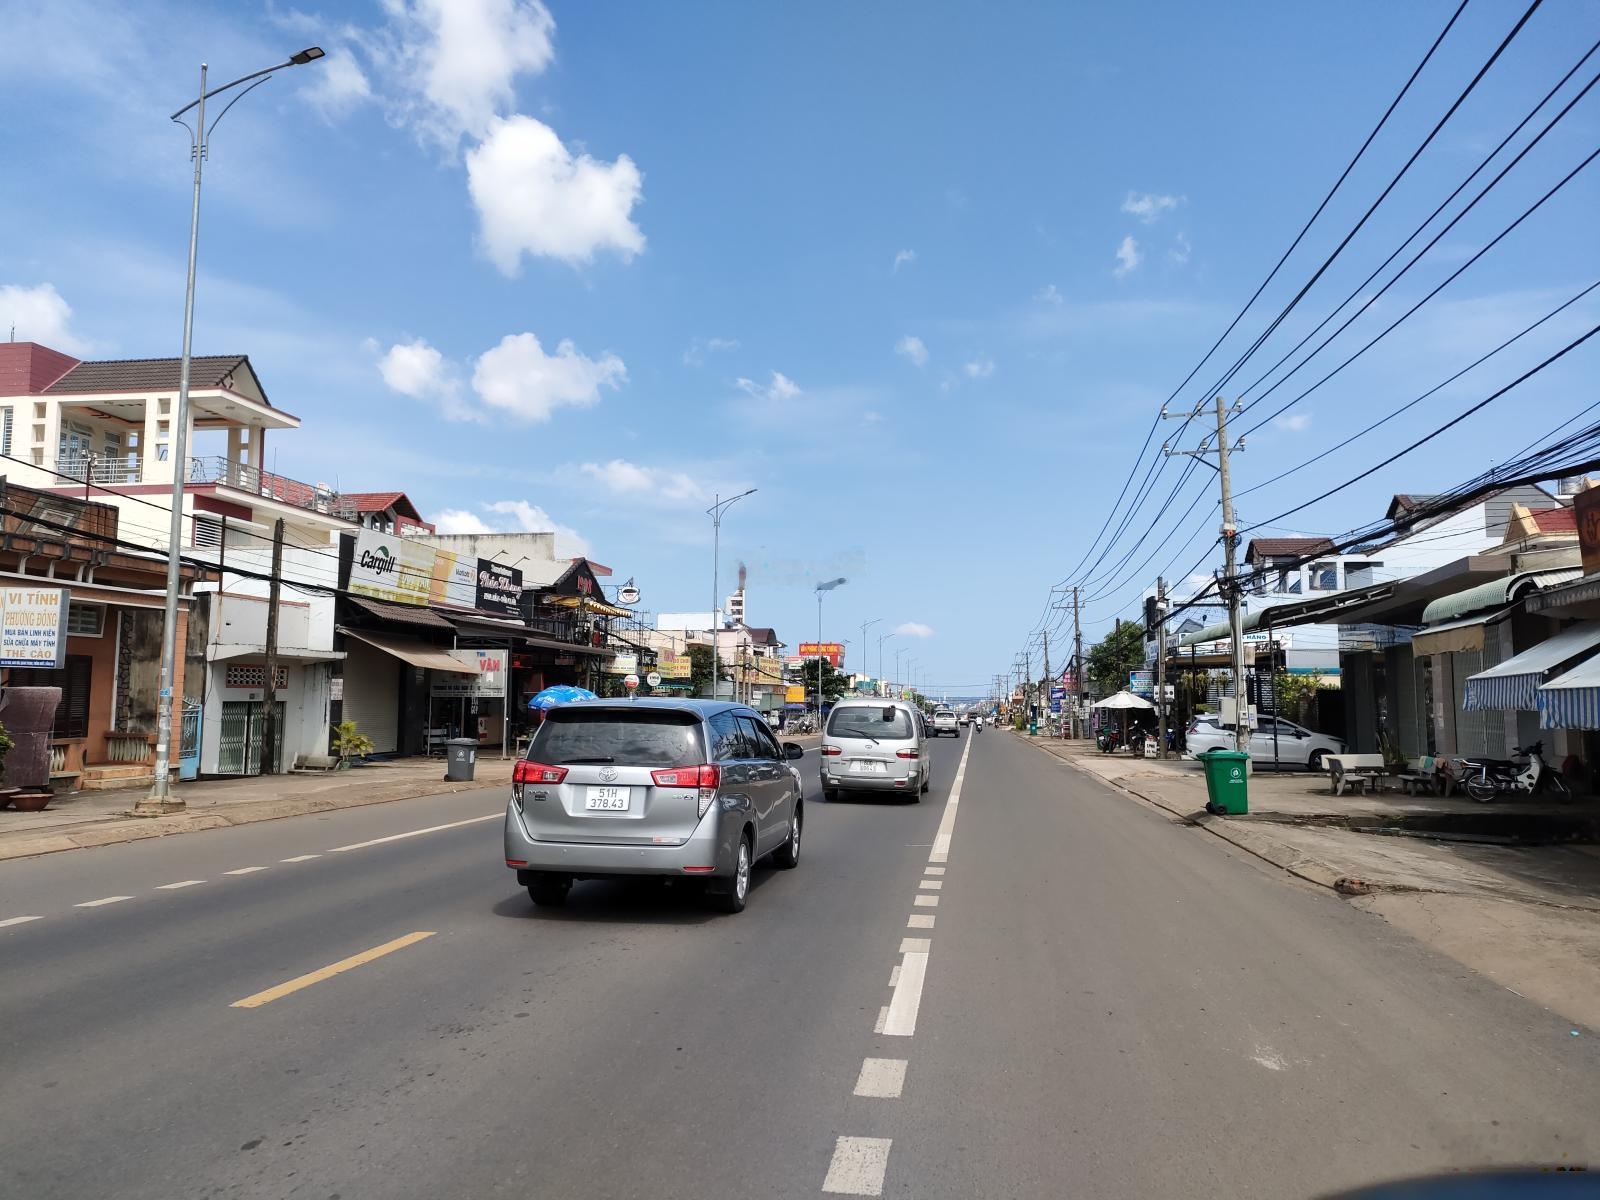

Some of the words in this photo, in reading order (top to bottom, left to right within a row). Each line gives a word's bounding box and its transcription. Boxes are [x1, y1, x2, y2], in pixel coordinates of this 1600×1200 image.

[361, 549, 396, 575] Cargill
[9, 592, 21, 604] VI
[27, 591, 58, 606] TÍNH
[17, 628, 28, 636] BÁN
[29, 629, 41, 637] LINH
[43, 640, 56, 648] TÍNH
[599, 788, 618, 798] 51H
[590, 798, 624, 809] 378.43
